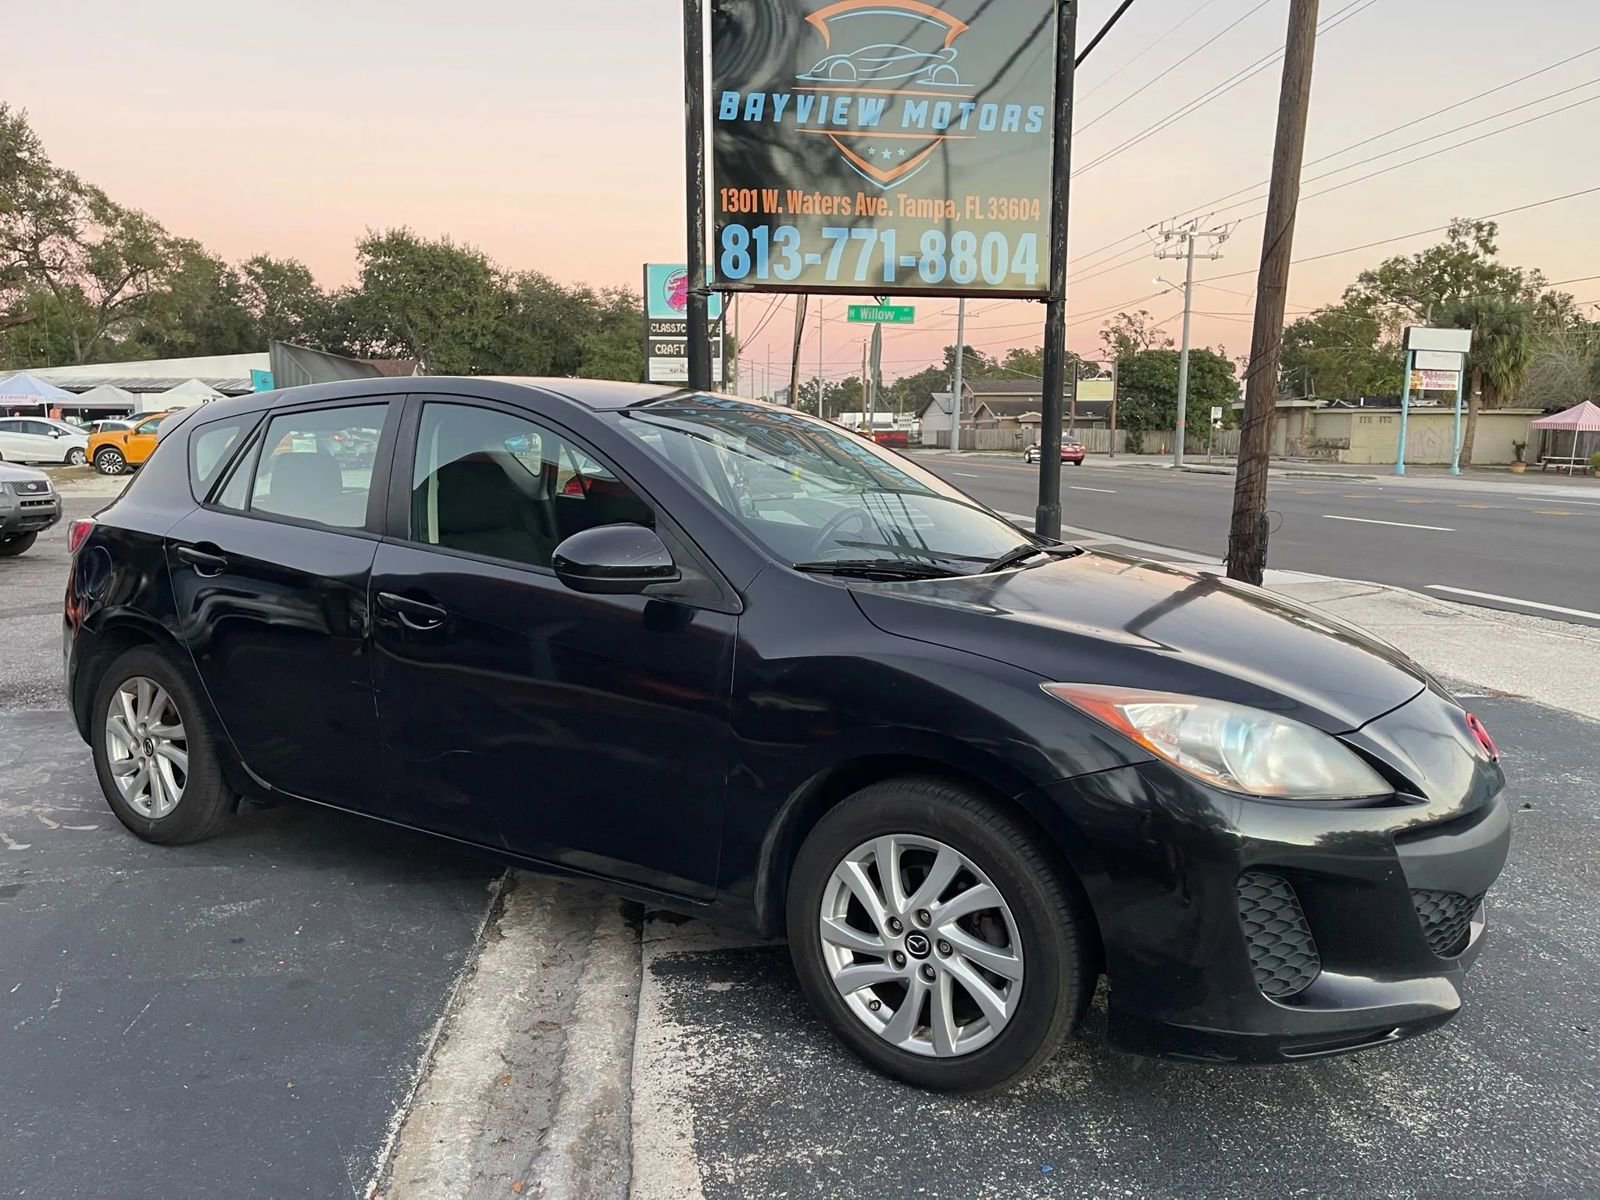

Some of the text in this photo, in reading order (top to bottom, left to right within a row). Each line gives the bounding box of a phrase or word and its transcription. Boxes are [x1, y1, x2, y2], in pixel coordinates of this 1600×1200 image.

[719, 91, 1045, 133] BAYVIEW MOTORS
[720, 188, 1040, 224] 1301 W. Waters Ave. Tampa, FL 33604
[720, 224, 1039, 285] 813-771-8804
[860, 307, 895, 321] Willow
[651, 323, 687, 333] CLASSIC
[655, 344, 686, 355] CRAFT
